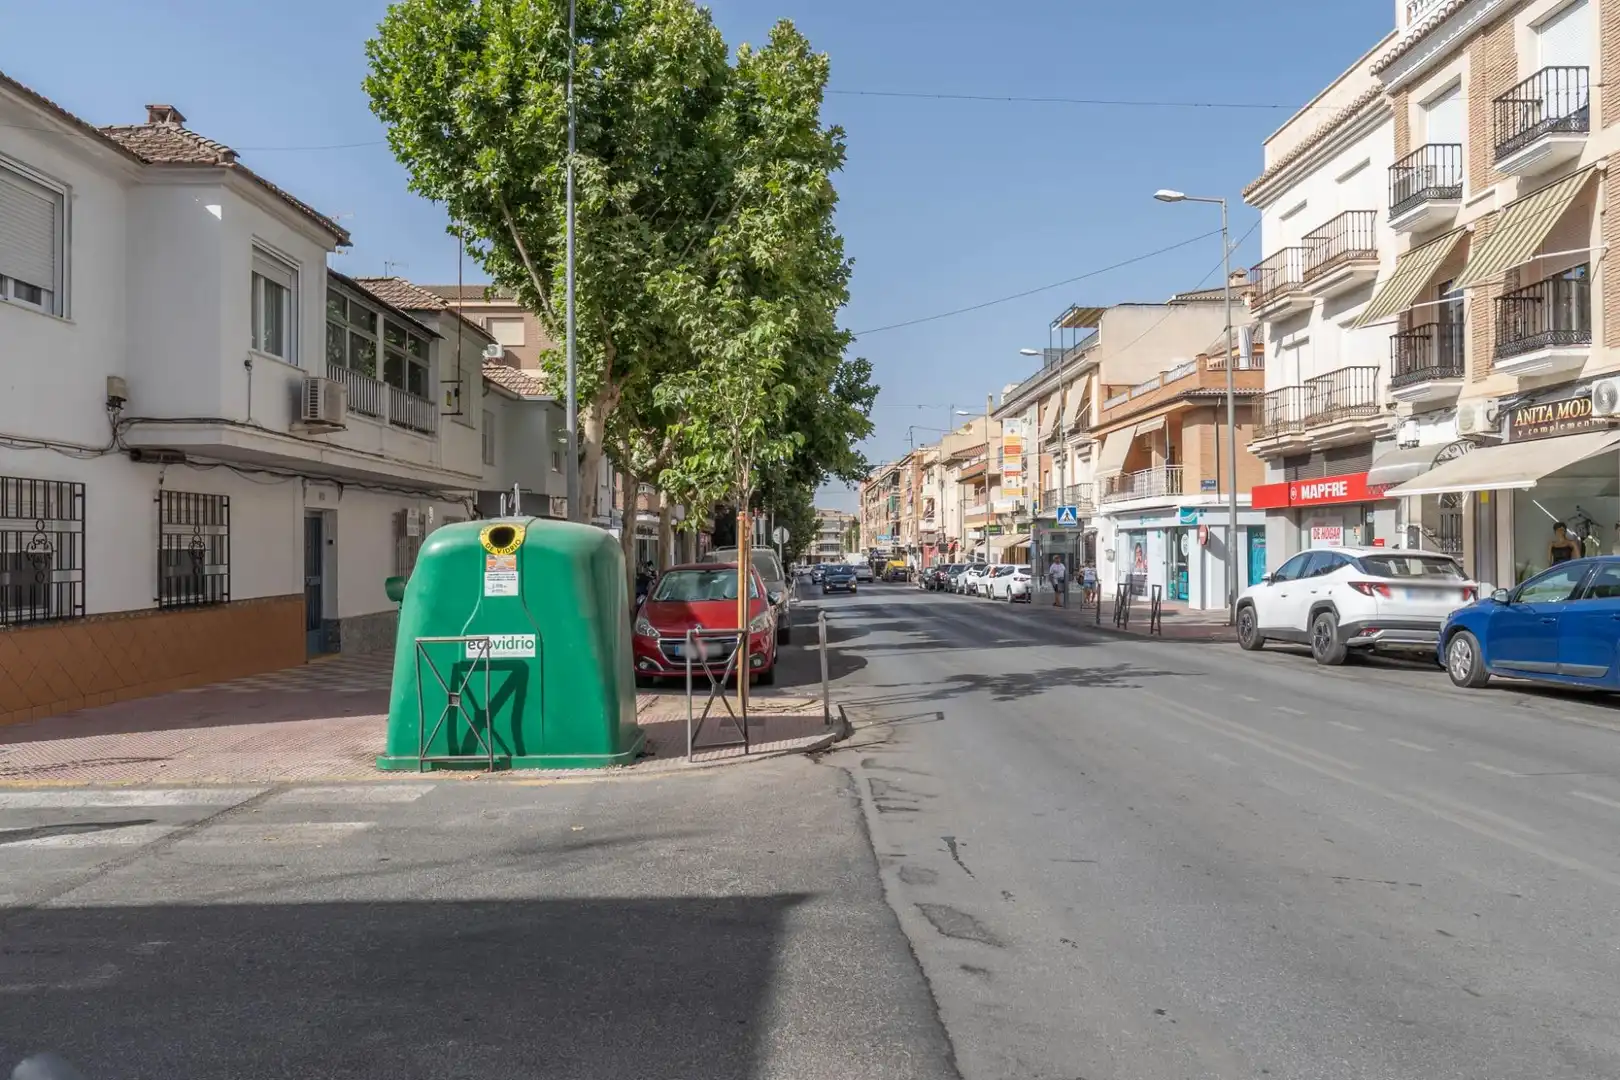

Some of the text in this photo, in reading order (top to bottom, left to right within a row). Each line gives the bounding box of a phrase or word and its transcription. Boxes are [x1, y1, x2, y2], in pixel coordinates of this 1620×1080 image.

[1514, 398, 1592, 427] ANITA MOD
[1301, 481, 1347, 499] MAPFRE
[1313, 527, 1341, 540] DE HOGAR
[496, 539, 522, 554] VIDRIO
[467, 635, 535, 650] ecovidrio
